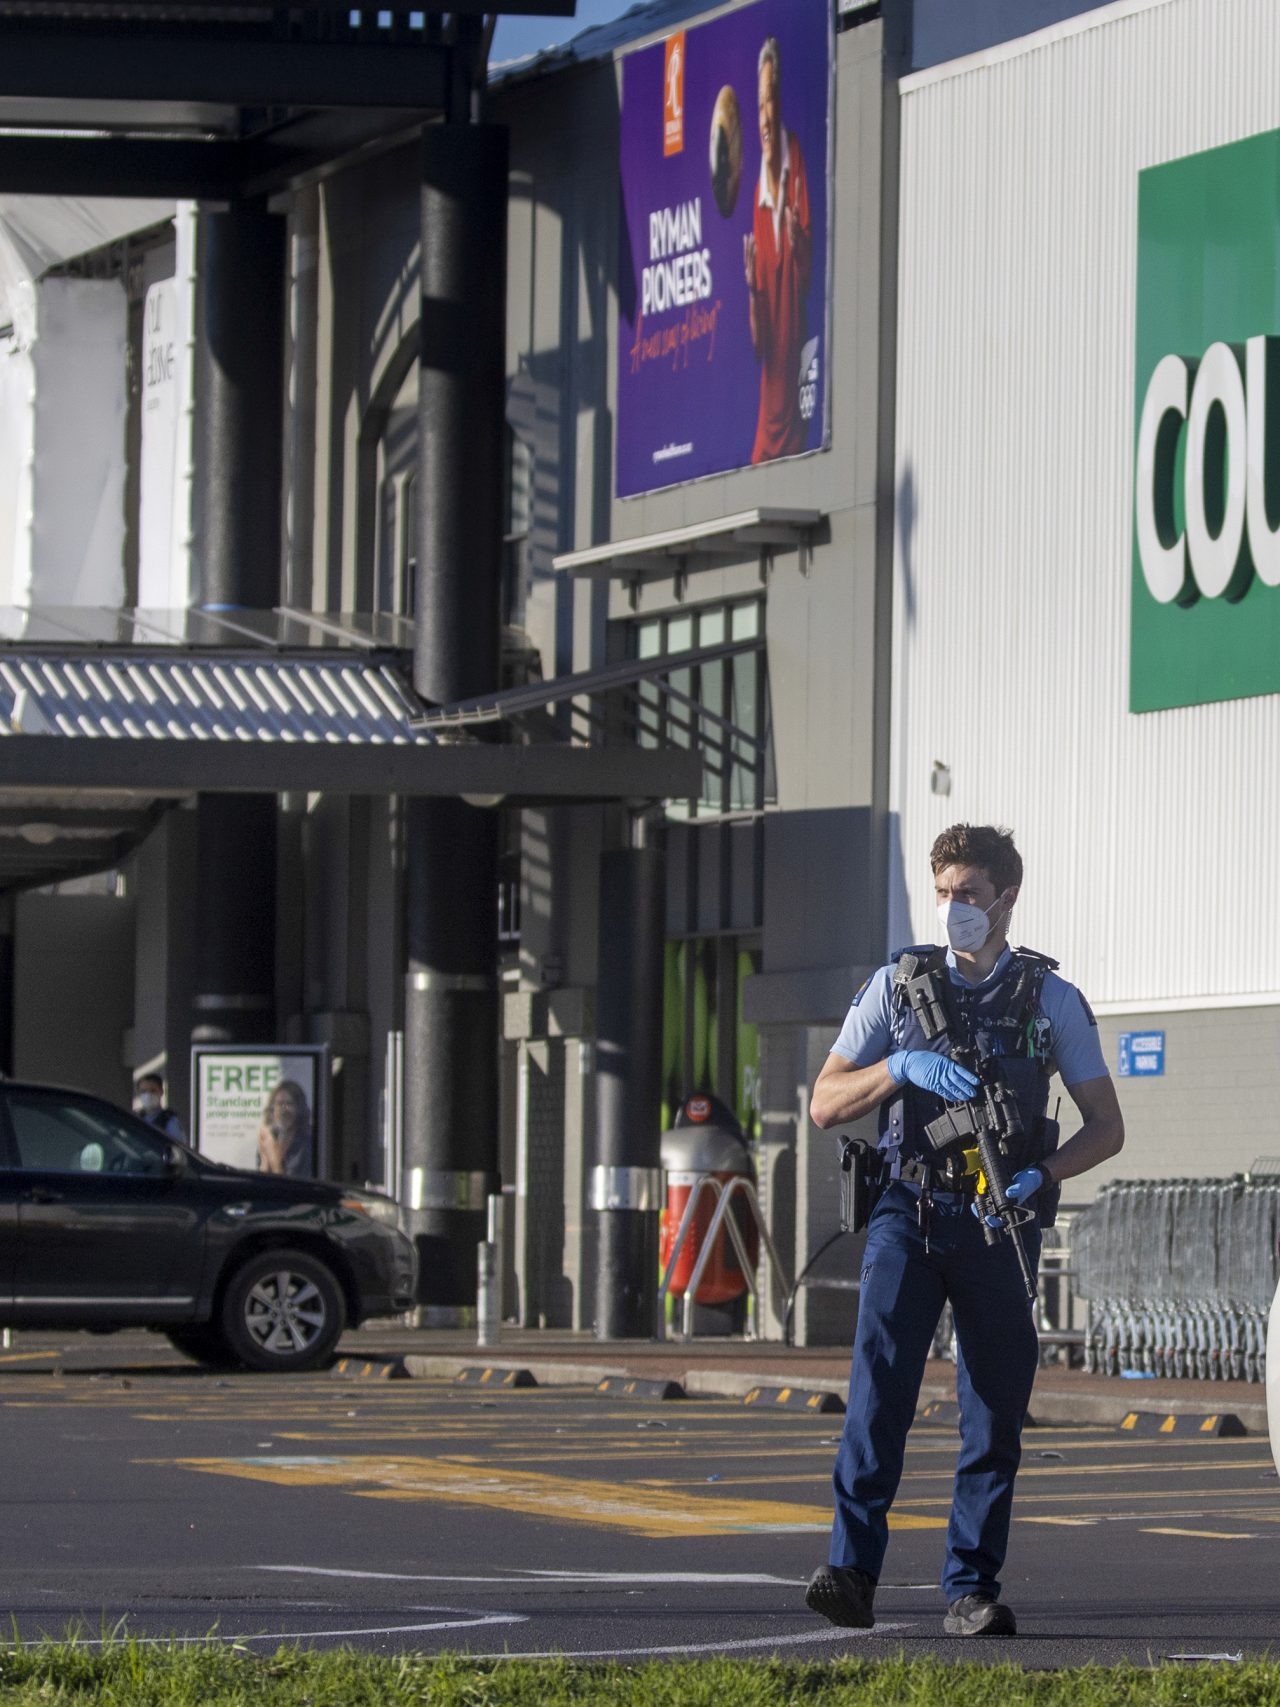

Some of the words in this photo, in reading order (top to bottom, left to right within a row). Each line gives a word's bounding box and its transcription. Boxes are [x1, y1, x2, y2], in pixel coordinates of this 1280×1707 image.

[650, 197, 703, 262] RYMAN
[642, 248, 713, 317] PIONEERS
[206, 1064, 280, 1093] FREE
[206, 1095, 261, 1108] Standard
